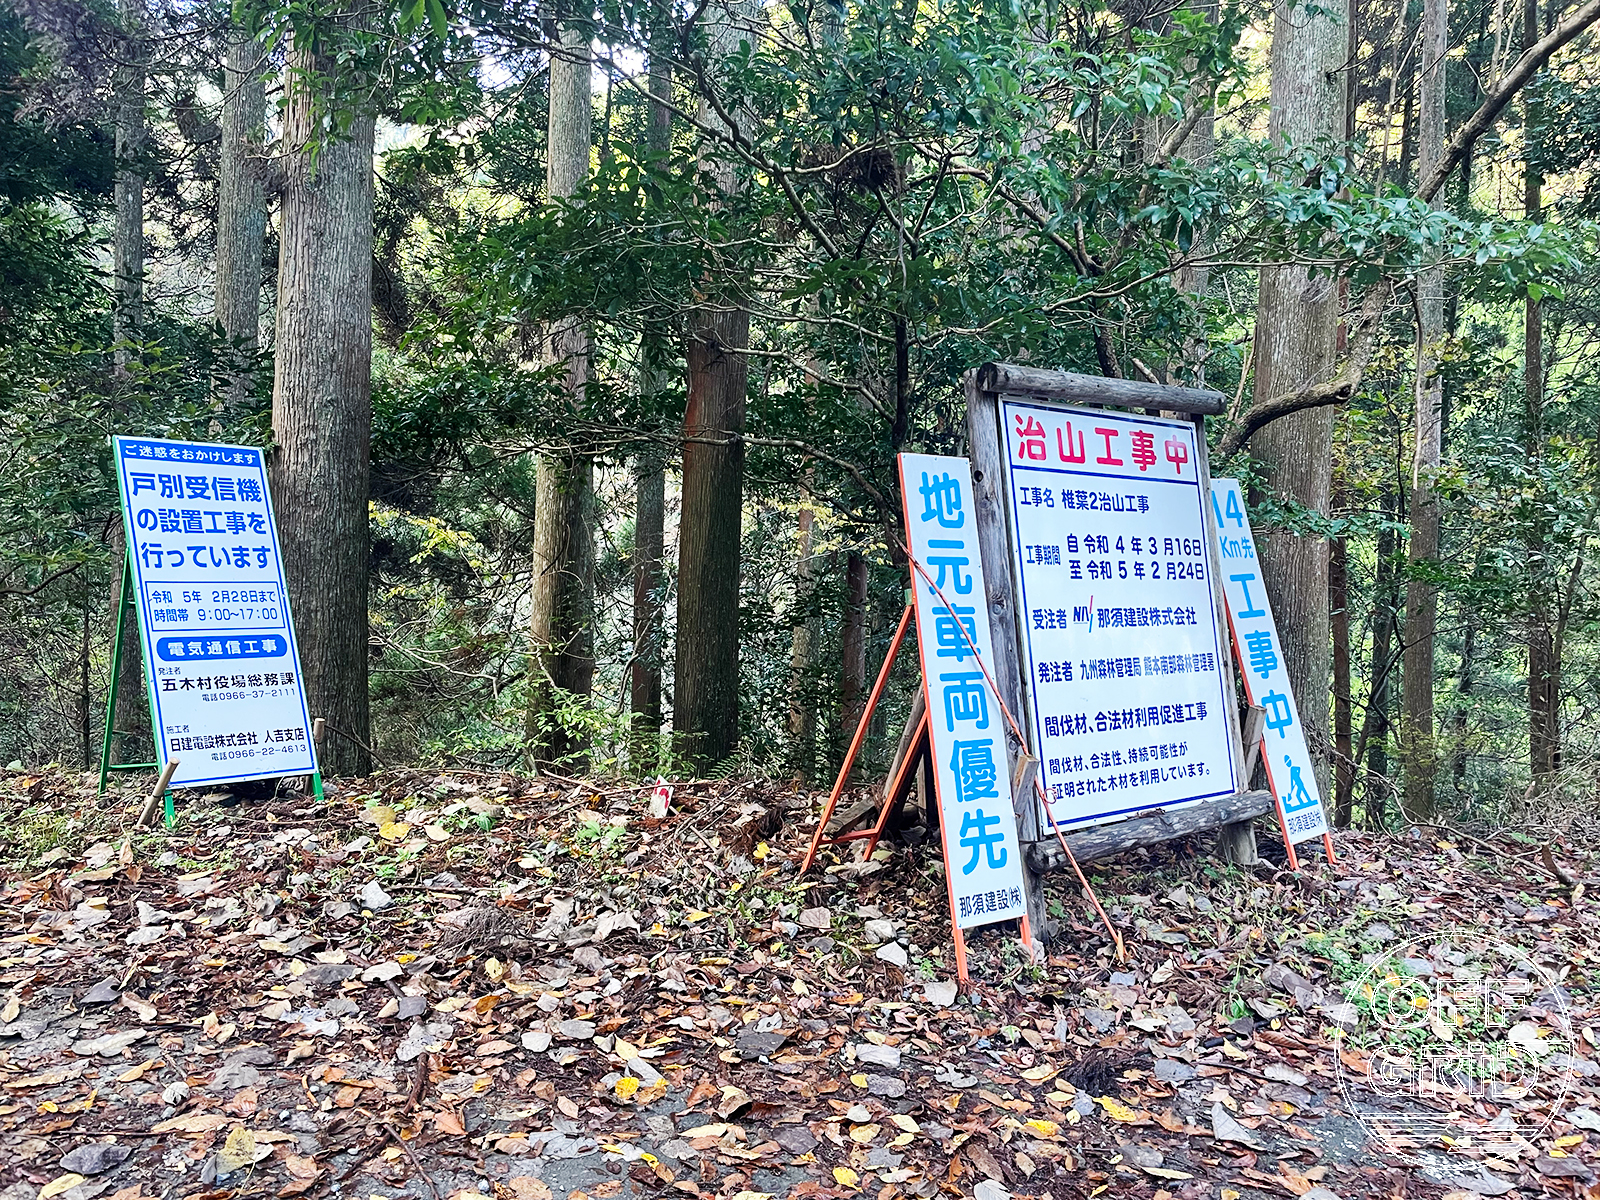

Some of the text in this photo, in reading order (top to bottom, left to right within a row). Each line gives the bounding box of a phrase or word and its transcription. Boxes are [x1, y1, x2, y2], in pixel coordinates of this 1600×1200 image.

[125, 444, 256, 464] ご迷惑をおかけします
[1015, 414, 1189, 475] 治山工事中
[130, 471, 263, 503] 戸別受信機
[1019, 486, 1150, 514] 工事名 椎葉2治山工事
[136, 508, 267, 535] の設置工事を
[140, 542, 271, 569] 行っています
[1025, 544, 1061, 566] 工事期間
[151, 590, 173, 604] 令和
[212, 590, 276, 603] 2月28日まで
[154, 608, 189, 623] 時間帯
[1032, 608, 1067, 630] 受注者
[1097, 606, 1198, 629] 那須建設株式会社
[167, 638, 278, 657] 電気通信工事
[1229, 572, 1293, 739] 工事中
[161, 672, 296, 692] 五木村役場総務課
[918, 470, 1008, 877] 地元車両優先
[1038, 660, 1073, 683] 発注者
[1080, 656, 1142, 681] 九州森林管理局
[1044, 701, 1208, 738] 間伐材、合法材利用促進工事
[170, 727, 306, 752] 日建電設株式会社 人吉支店
[1048, 741, 1188, 776] 間伐材、合法性、持続可能性が
